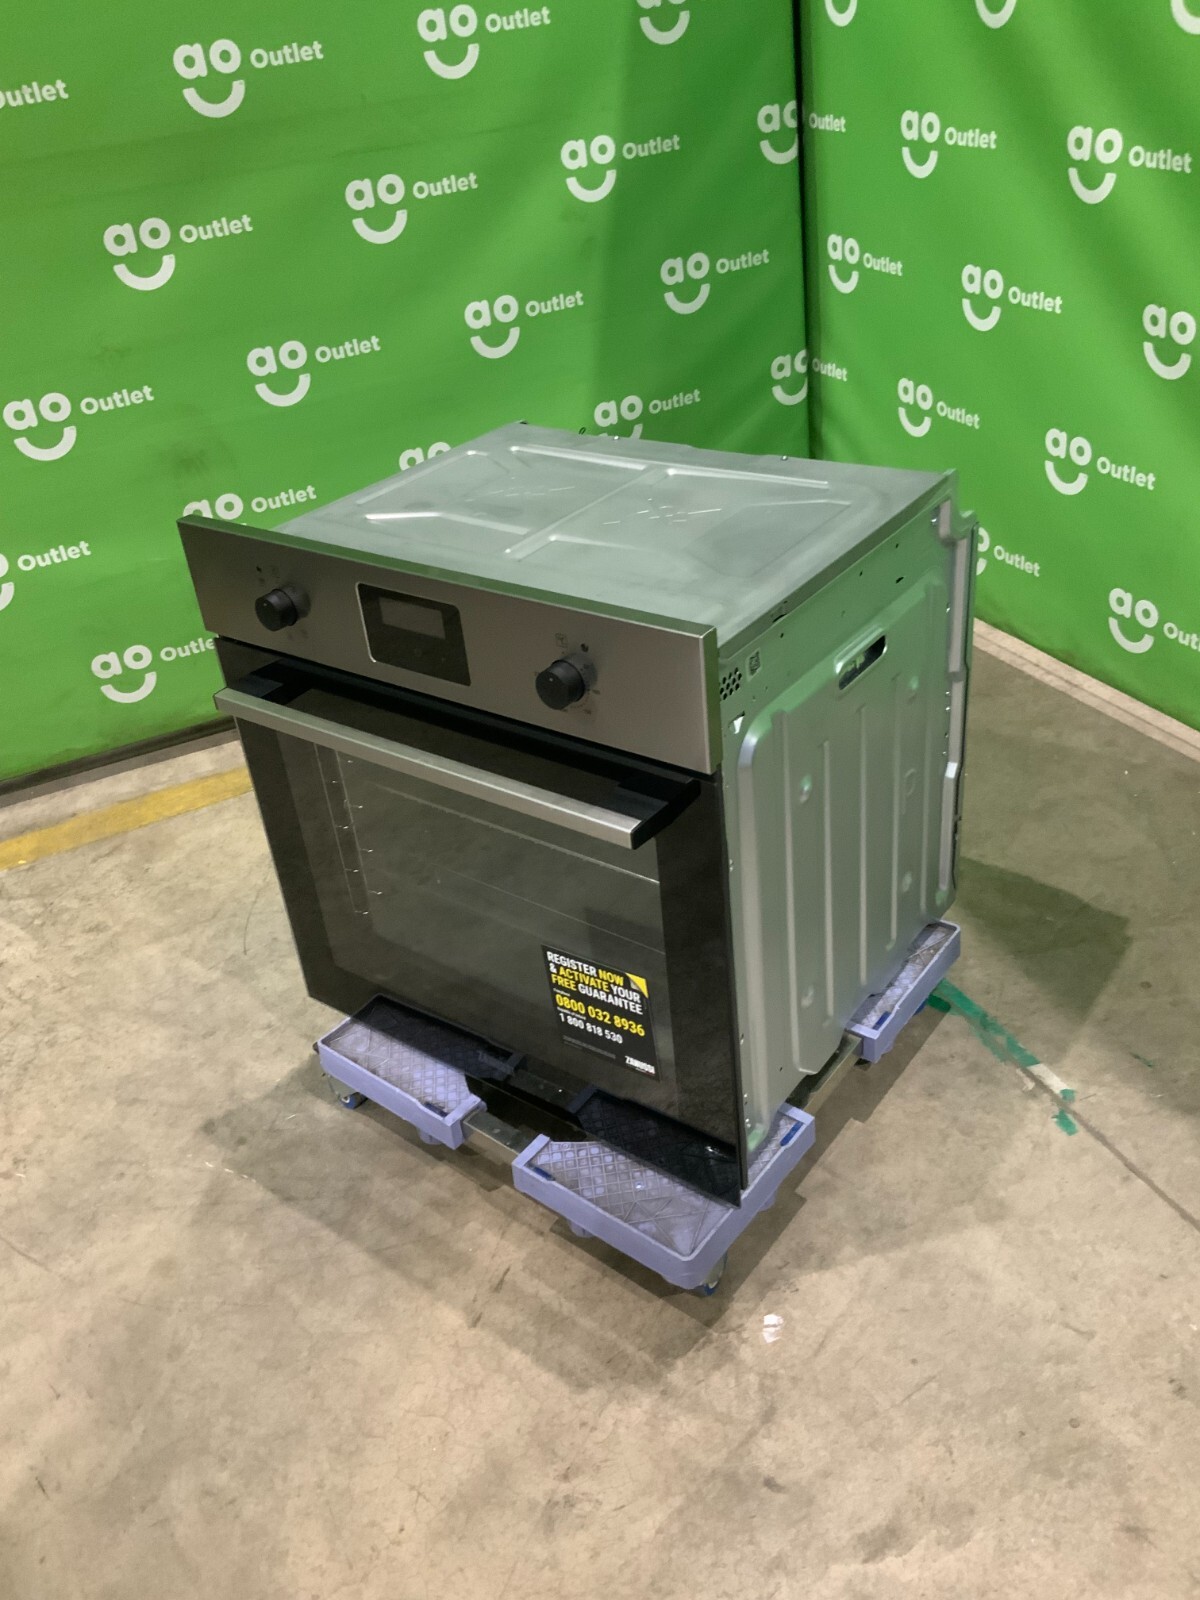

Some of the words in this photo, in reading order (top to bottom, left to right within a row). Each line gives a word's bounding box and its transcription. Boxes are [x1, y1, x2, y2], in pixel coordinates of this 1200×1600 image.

[416, 3, 479, 42] ao
[485, 6, 551, 33] Outlet
[172, 38, 242, 80] ao
[249, 40, 324, 69] Outlet
[809, 113, 847, 133] Outlet
[900, 109, 941, 144] ao
[944, 126, 998, 150] Outlet
[560, 134, 617, 171] ao
[622, 134, 680, 160] Outlet
[1066, 124, 1125, 165] ao
[1127, 145, 1193, 174] Outlet
[344, 173, 406, 211] ao
[412, 172, 478, 200] Outlet
[102, 217, 172, 257] ao
[178, 214, 254, 244] Outlet
[826, 233, 861, 265] ao
[862, 252, 903, 277] Outlet
[660, 252, 710, 286] ao
[716, 249, 769, 275] Outlet
[463, 294, 520, 330] ao
[525, 290, 584, 317] Outlet
[960, 263, 1005, 300] ao
[1007, 285, 1063, 315] Outlet
[1142, 303, 1198, 346] ao
[246, 339, 308, 377] ao
[314, 335, 381, 363] Outlet
[812, 358, 848, 382] Outlet
[2, 391, 72, 431] ao
[79, 385, 155, 415] Outlet
[593, 395, 643, 428] ao
[648, 388, 701, 415] Outlet
[897, 377, 934, 411] ao
[936, 400, 981, 430] Outlet
[1044, 427, 1093, 467] ao
[1096, 455, 1157, 491] Outlet
[250, 484, 318, 513] Outlet
[17, 540, 92, 572] Outlet
[993, 544, 1041, 578] Outlet
[1108, 587, 1160, 629] ao
[1162, 621, 1200, 653] Out
[90, 644, 153, 680] ao
[160, 634, 219, 662] Outle
[546, 951, 598, 978] REGISTER
[598, 968, 624, 987] NOW
[549, 962, 558, 974] &
[559, 966, 610, 993] ACTIVATE
[610, 983, 642, 1004] YOUR
[551, 973, 577, 992] FREE
[577, 983, 644, 1016] GUARANTEE
[555, 993, 586, 1015] 0800
[587, 1005, 612, 1025] 032
[613, 1015, 646, 1037] 8936
[559, 1012, 566, 1023] 1
